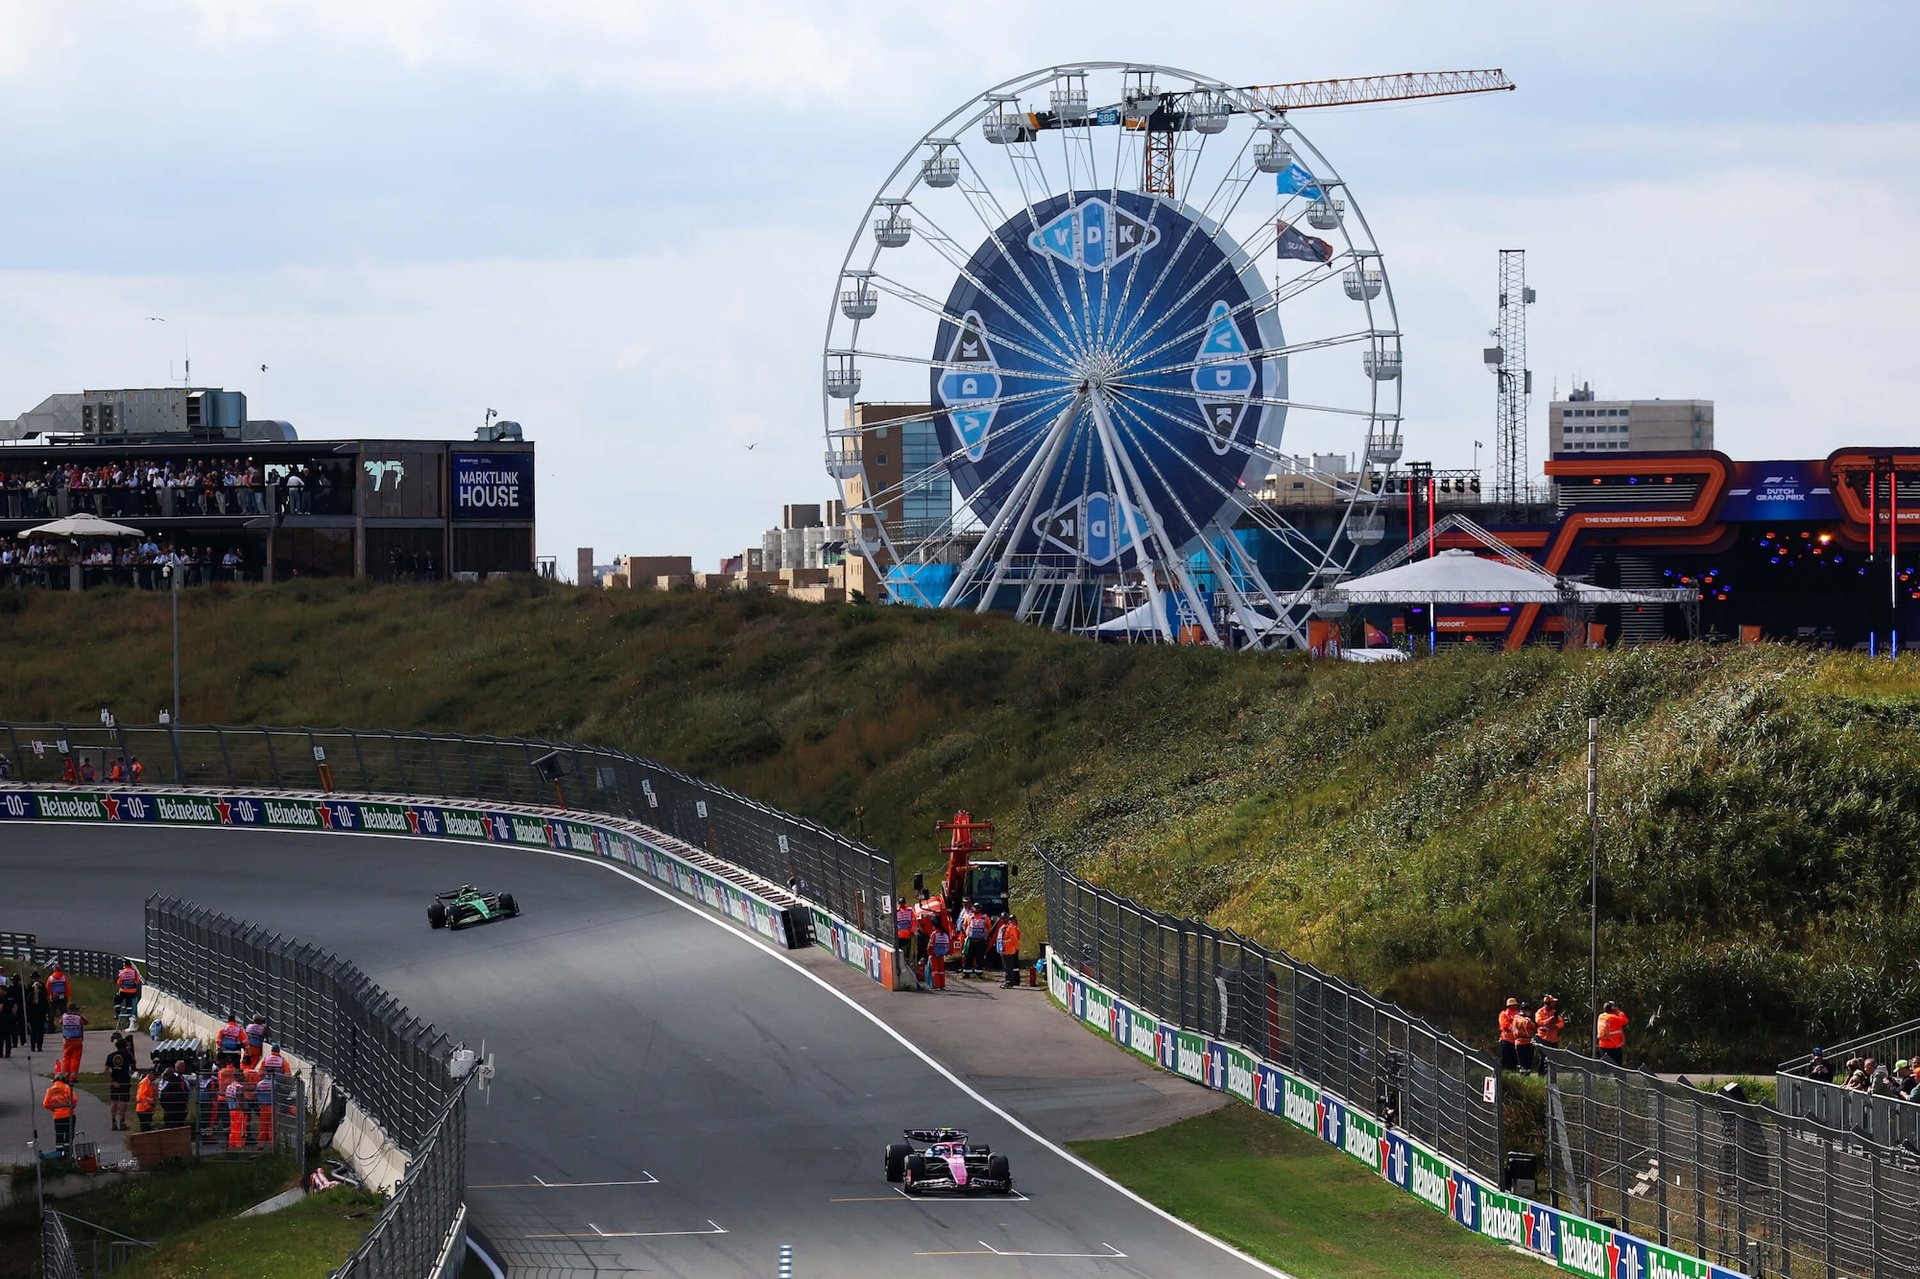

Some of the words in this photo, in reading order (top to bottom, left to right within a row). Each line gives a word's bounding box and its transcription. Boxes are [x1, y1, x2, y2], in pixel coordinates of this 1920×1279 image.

[1098, 114, 1115, 123] SBB
[1054, 227, 1134, 246] VDK
[962, 341, 978, 432] VDK
[1216, 331, 1232, 425] VDK
[460, 471, 518, 485] MARKTLINK
[460, 486, 519, 507] HOUSE
[38, 796, 101, 818] Heineken
[157, 798, 214, 822] Heineken
[265, 802, 318, 826] Heineken
[360, 807, 408, 831] Heineken
[443, 812, 484, 837] Heineken
[512, 818, 546, 844] Heineken
[1284, 1080, 1314, 1130] Heineken
[1344, 1112, 1378, 1168] Heineken
[1412, 1152, 1446, 1211] Heineken
[1480, 1191, 1522, 1244] Heineken
[1560, 1220, 1604, 1278] Heineken
